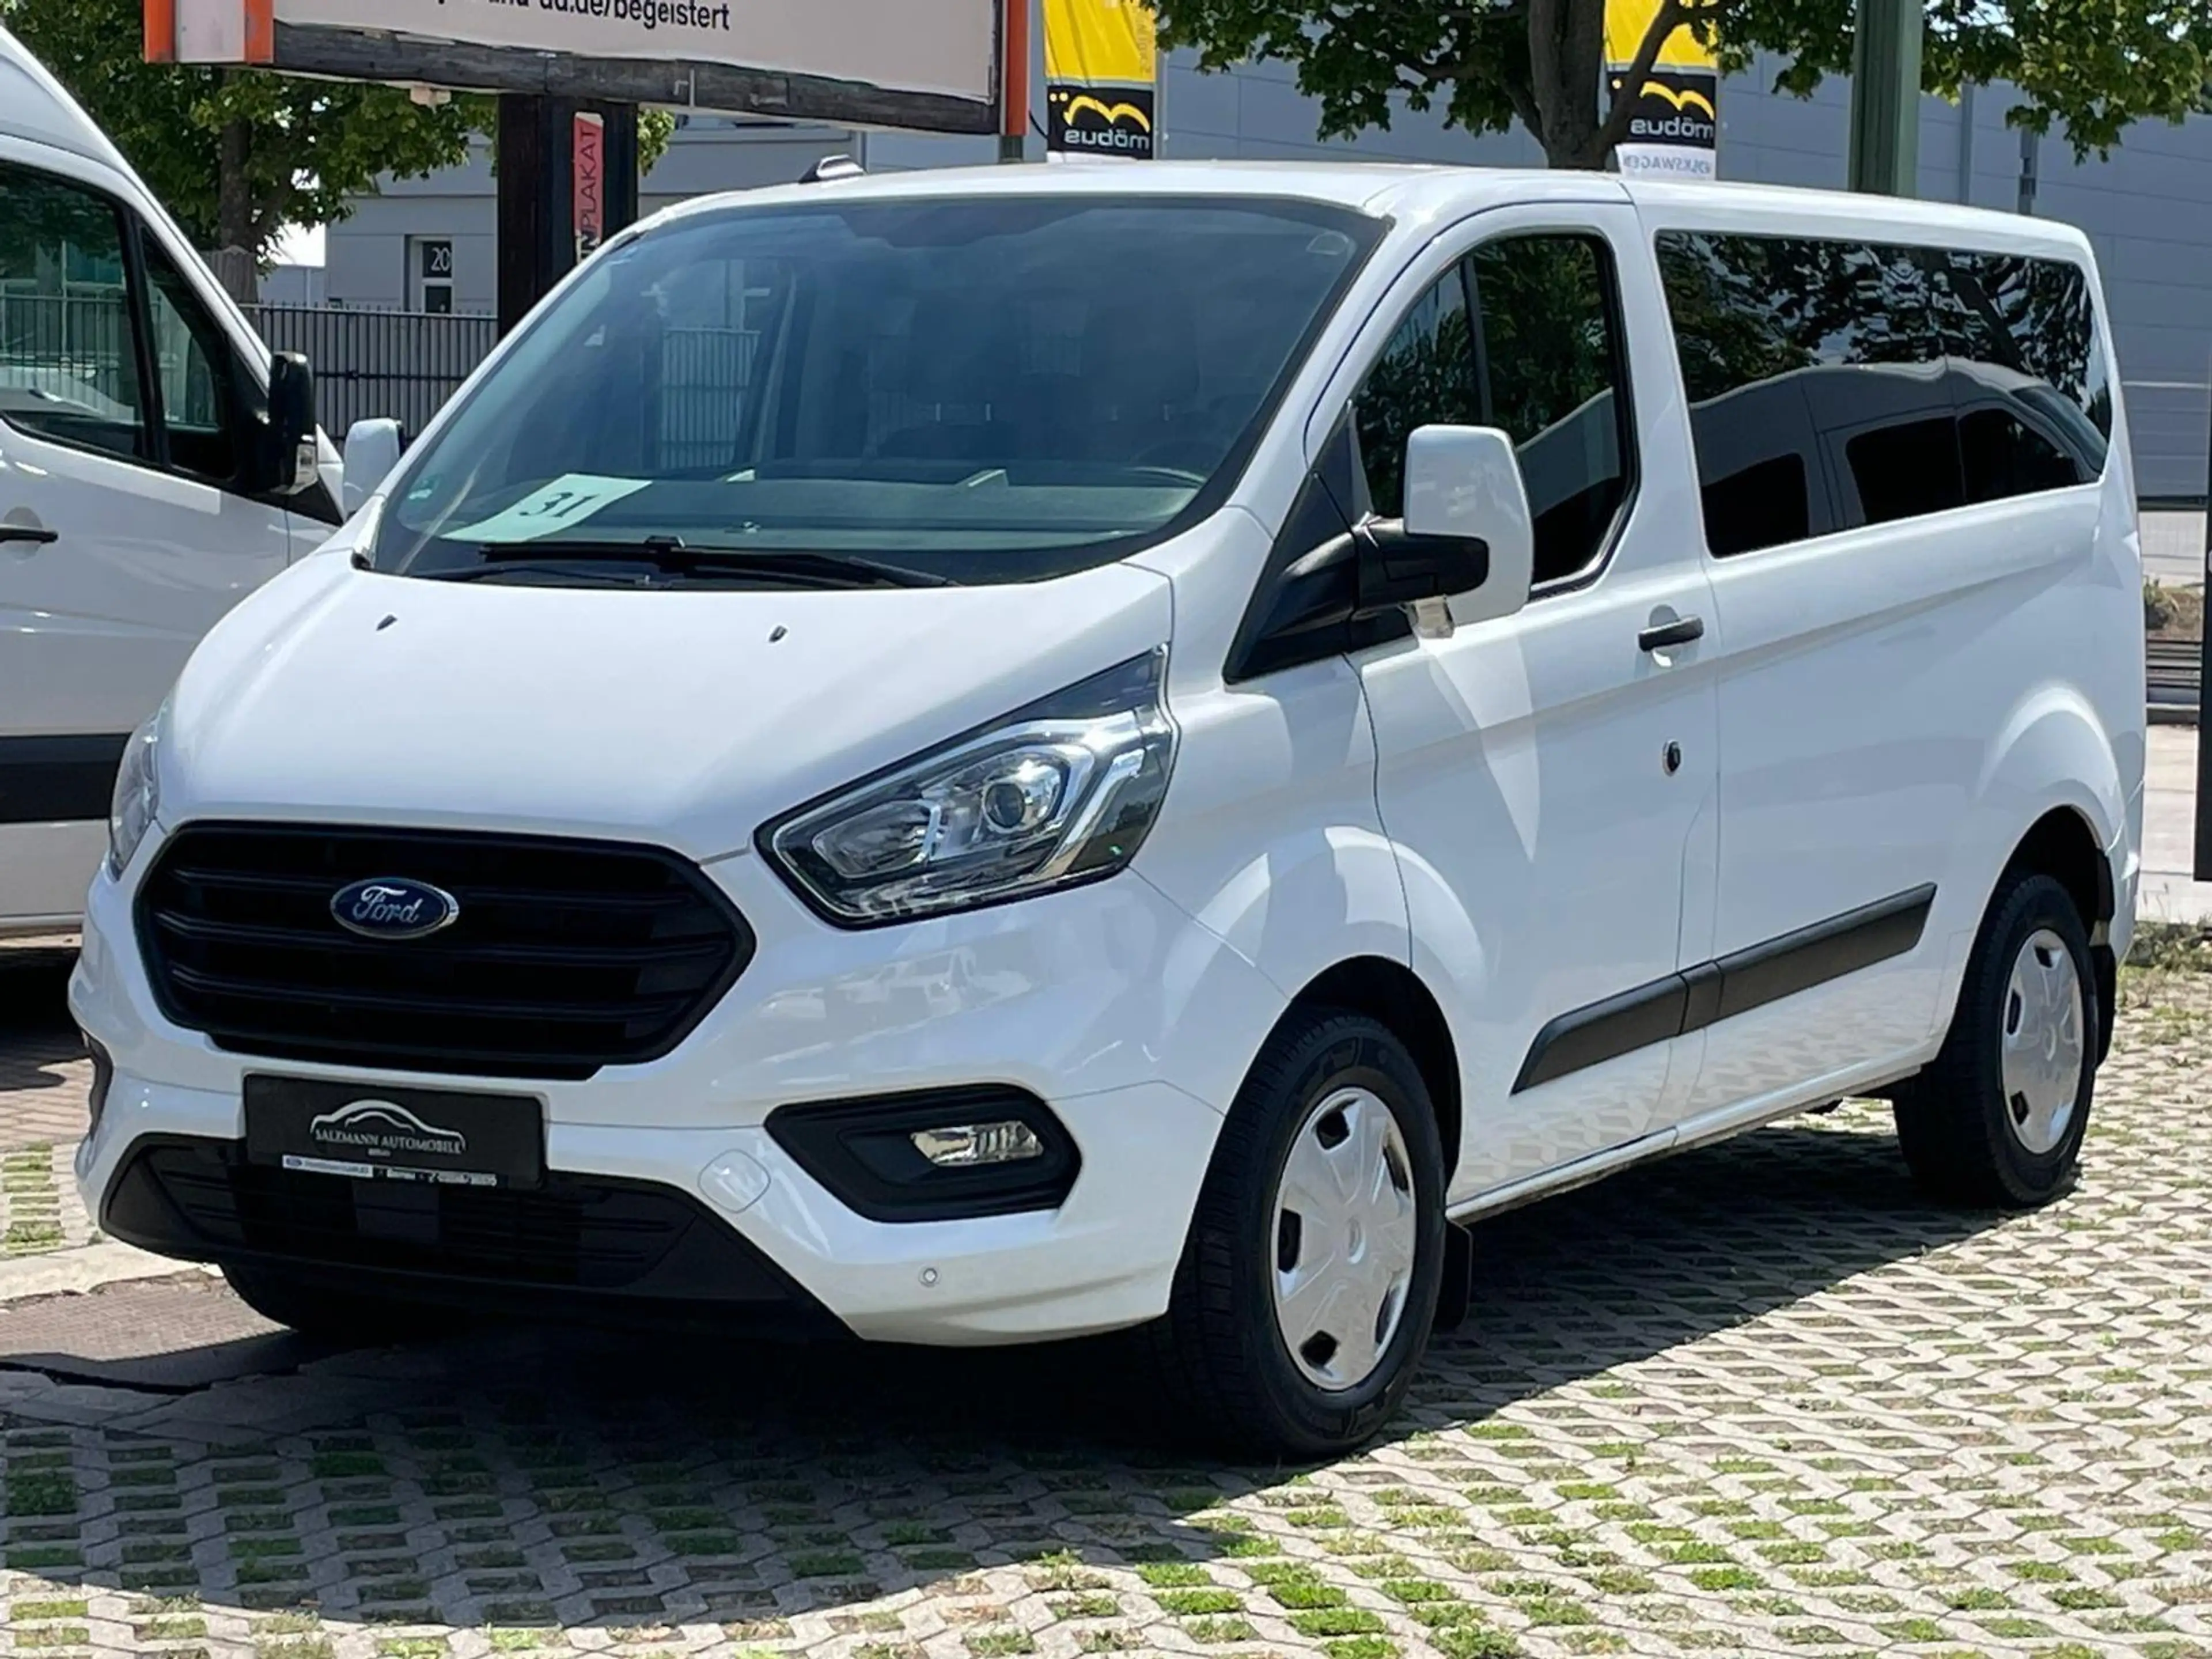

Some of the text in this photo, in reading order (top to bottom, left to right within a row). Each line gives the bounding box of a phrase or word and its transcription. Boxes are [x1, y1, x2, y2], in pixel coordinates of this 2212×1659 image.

[431, 247, 450, 271] 20
[520, 491, 598, 517] 31
[353, 886, 423, 923] Ford
[316, 1127, 378, 1146] SALZMANN
